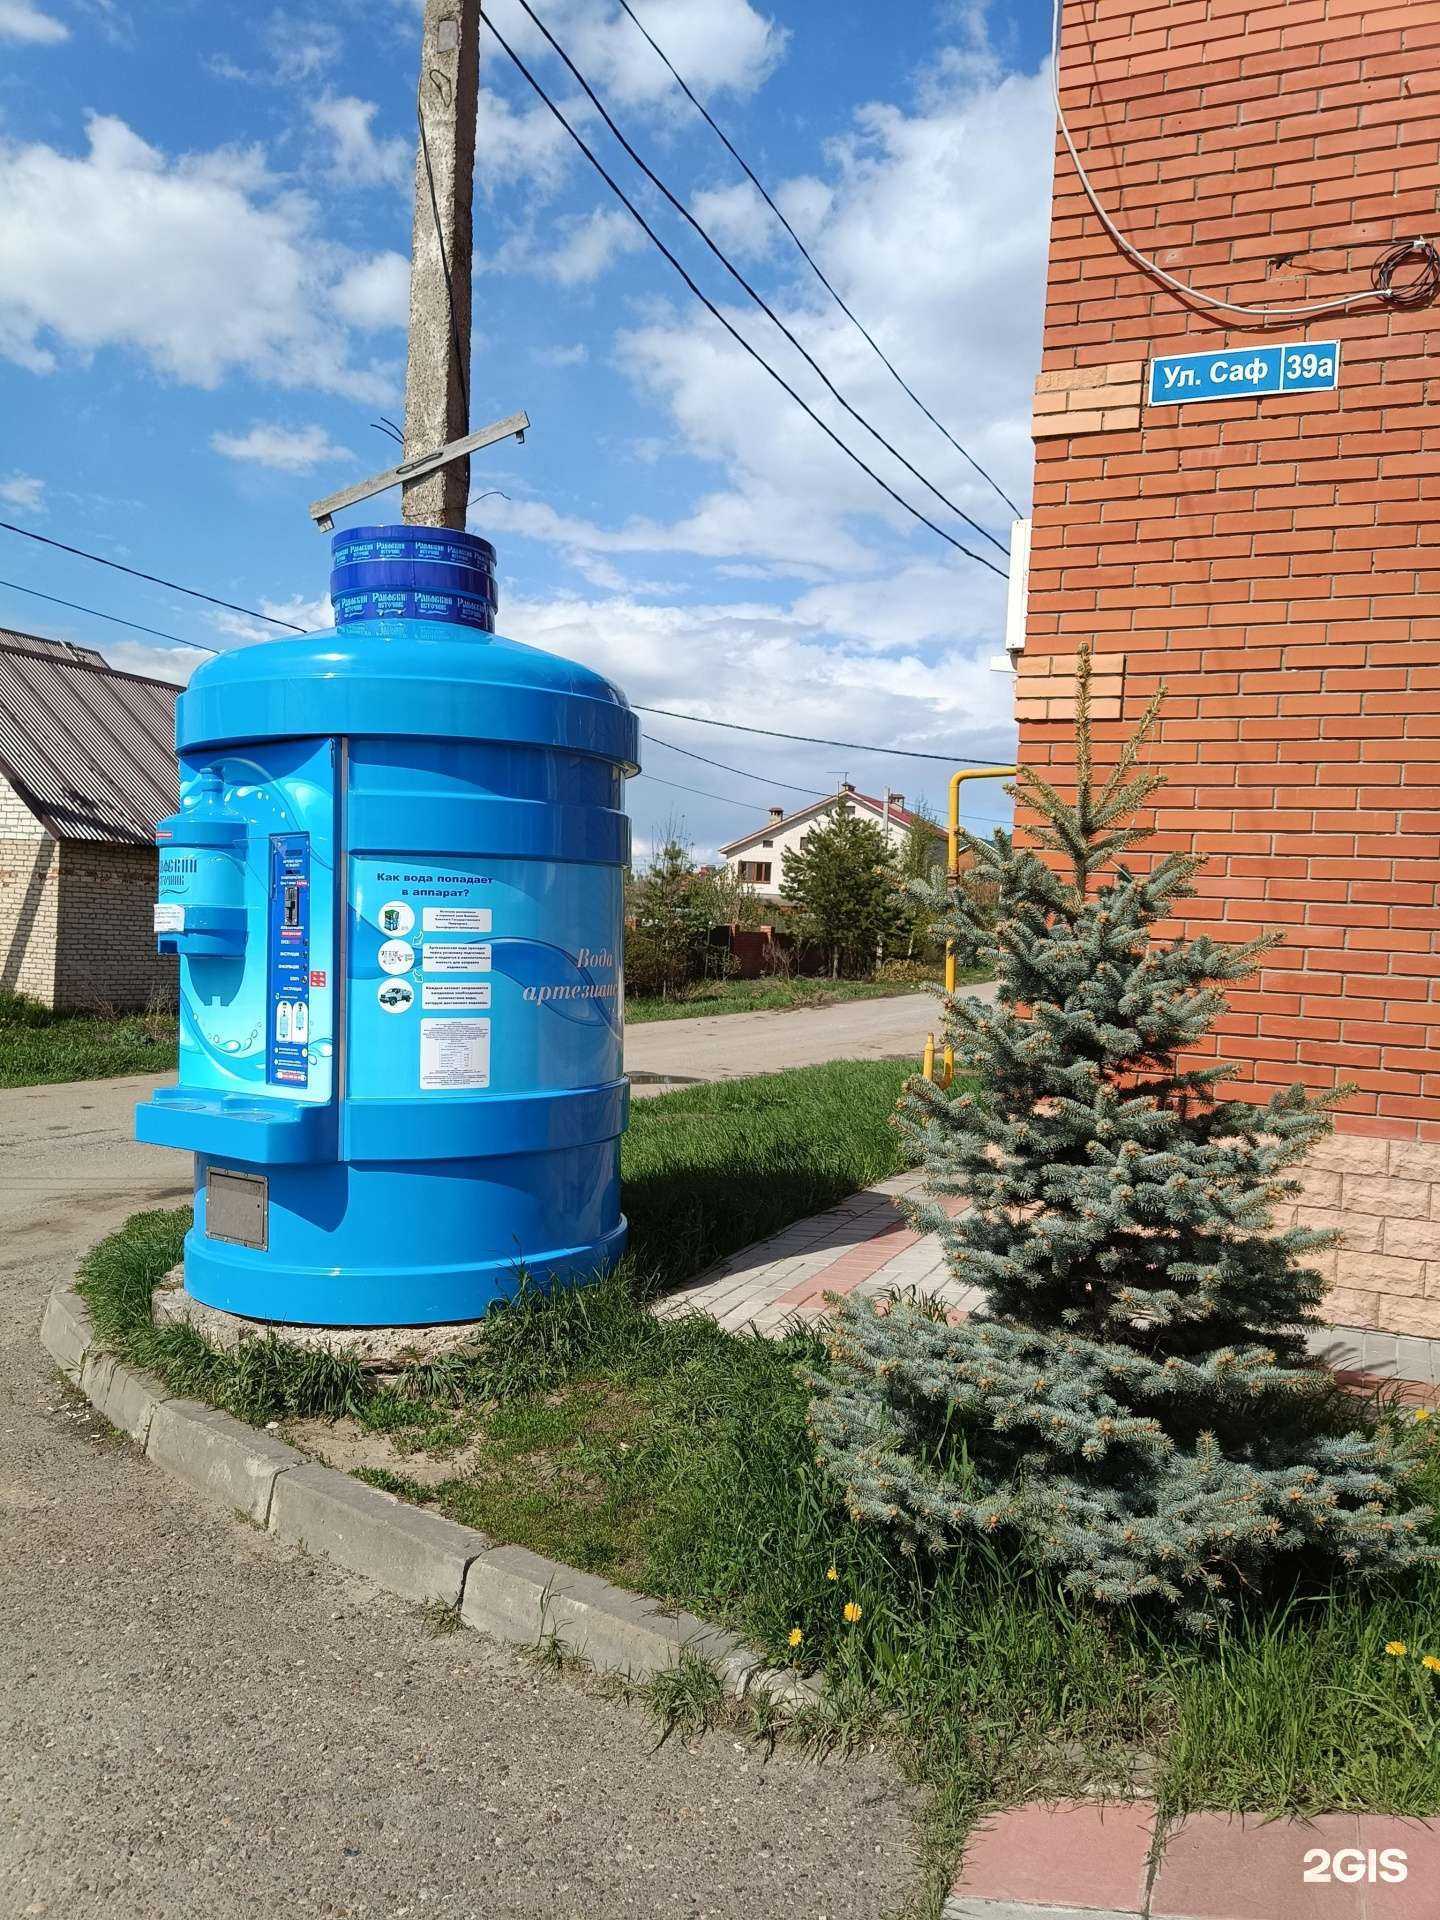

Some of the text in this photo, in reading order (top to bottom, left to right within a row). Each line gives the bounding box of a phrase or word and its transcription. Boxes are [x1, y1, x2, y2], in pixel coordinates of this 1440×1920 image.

[1163, 353, 1333, 389] Ул. Саф 39а
[376, 872, 493, 885] Как вода попадает
[413, 889, 470, 898] аппарат?
[577, 948, 613, 968] Вода
